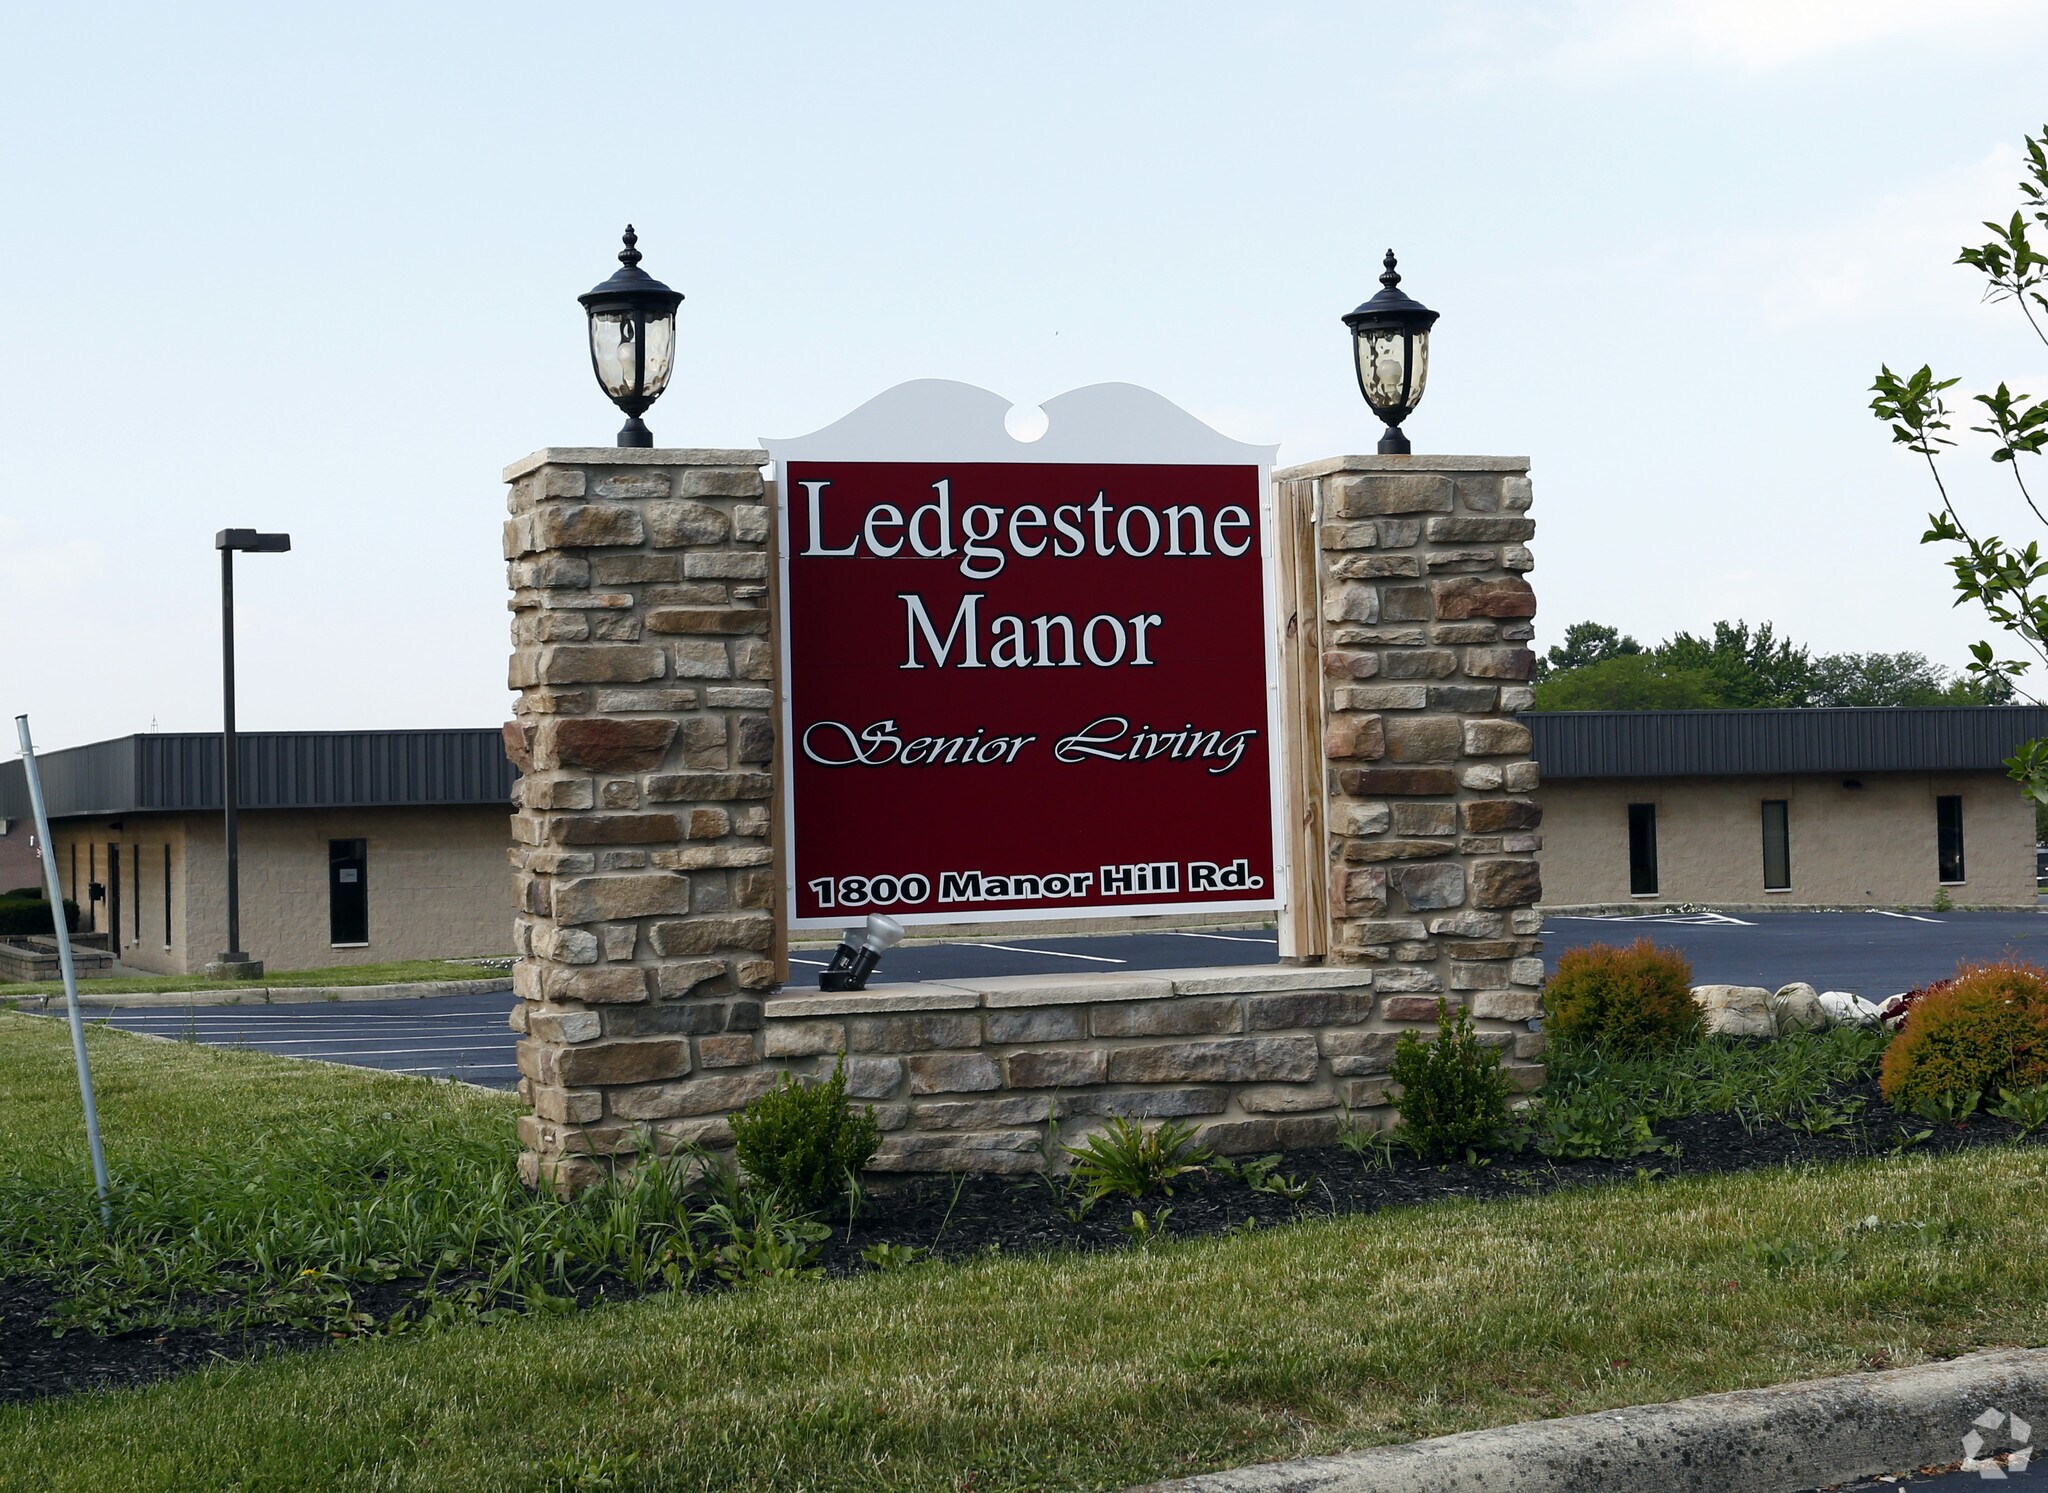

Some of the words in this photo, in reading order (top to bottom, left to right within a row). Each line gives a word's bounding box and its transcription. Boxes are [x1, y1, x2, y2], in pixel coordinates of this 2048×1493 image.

[798, 479, 1251, 579] Ledgestone
[898, 594, 1162, 668] Manor
[802, 719, 1036, 765] Senior
[1054, 717, 1257, 773] Living
[808, 874, 931, 908] 1800
[938, 871, 1094, 903] Manor
[1100, 862, 1180, 896] Hill
[1188, 859, 1264, 892] Rd.
